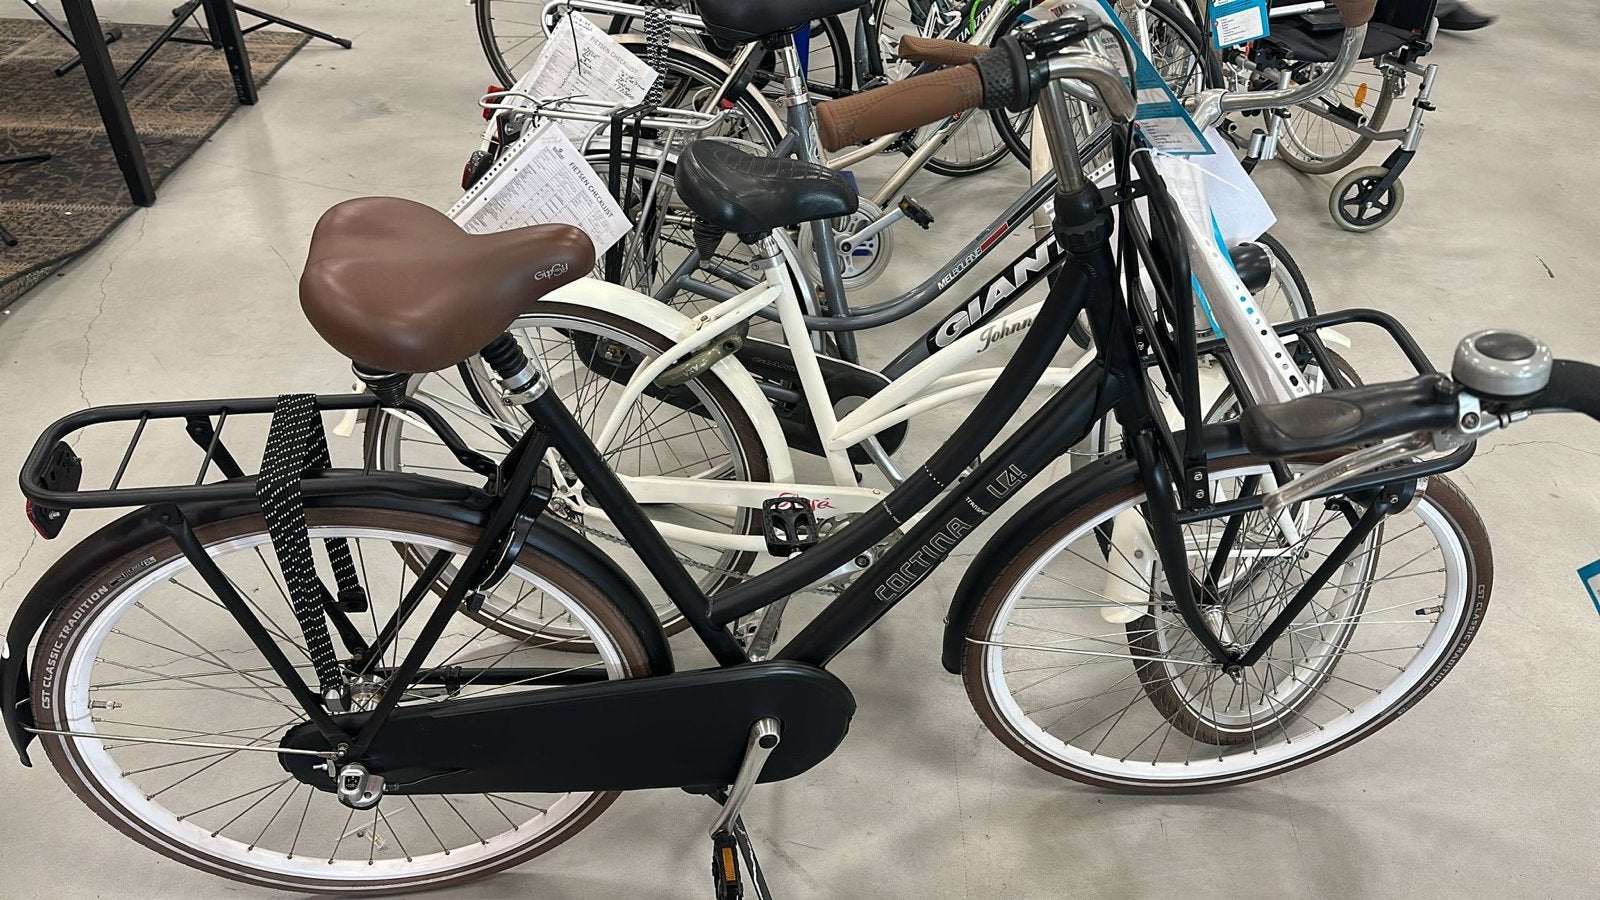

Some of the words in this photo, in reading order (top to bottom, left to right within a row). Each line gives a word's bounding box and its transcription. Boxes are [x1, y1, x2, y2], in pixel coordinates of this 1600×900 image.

[568, 162, 590, 186] FIETSEN
[588, 184, 614, 218] CHECKLIST
[937, 247, 982, 291] MELBOURNE
[874, 517, 973, 602] CORTINA
[60, 585, 109, 640] TRADITION
[1477, 584, 1486, 600] CST
[1462, 602, 1484, 641] CLASSIC
[43, 639, 64, 689] CLASSIC
[1429, 640, 1468, 688] TRADITION
[41, 691, 51, 710] CST
